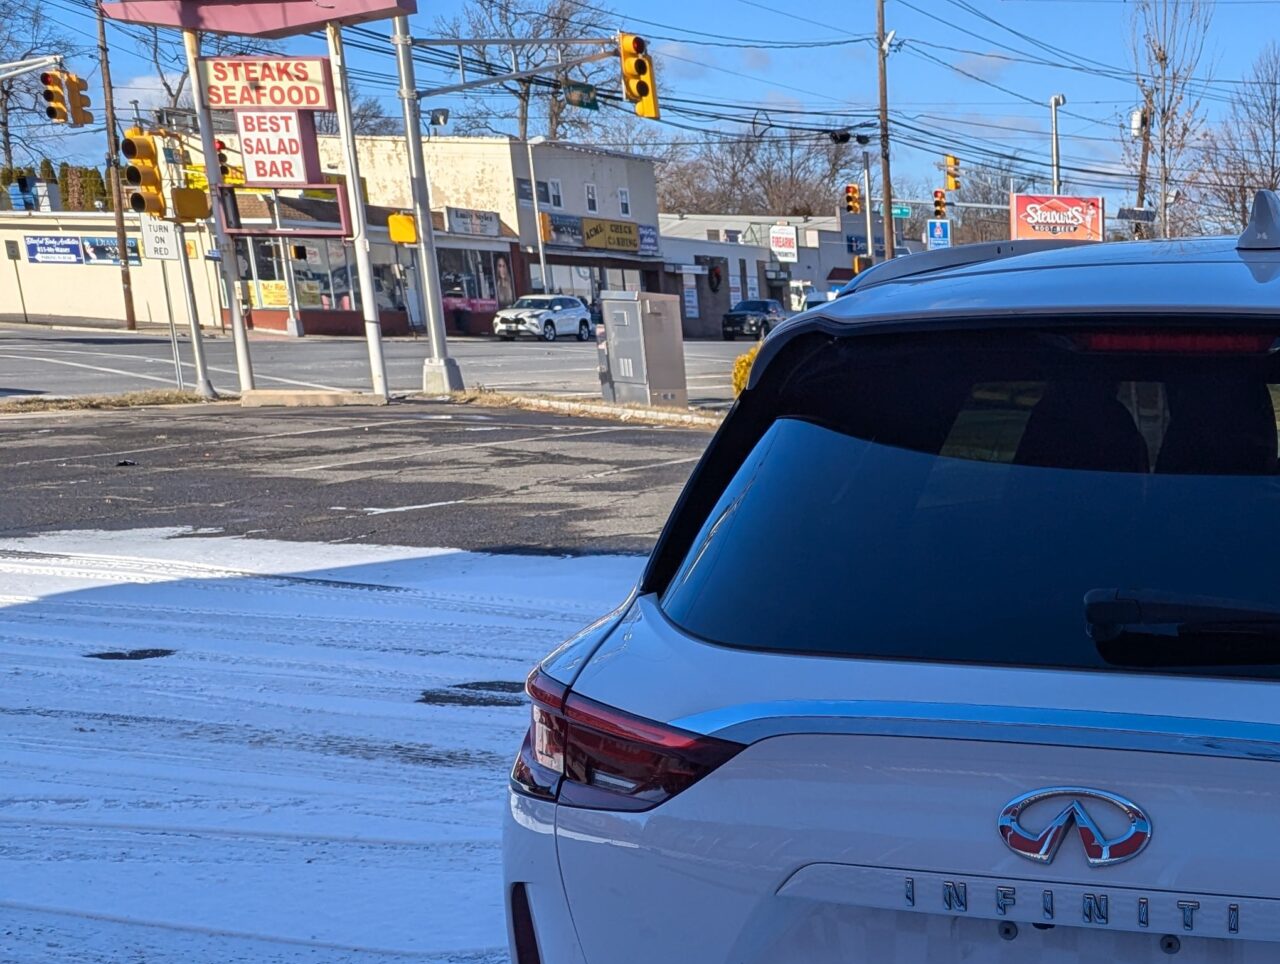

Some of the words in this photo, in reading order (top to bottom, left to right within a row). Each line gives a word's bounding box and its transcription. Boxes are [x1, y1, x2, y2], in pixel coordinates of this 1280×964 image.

[213, 62, 309, 82] STEAKS
[207, 85, 320, 105] SEAFOOD
[243, 115, 292, 133] BEST
[243, 138, 300, 155] SALAD
[255, 160, 295, 178] BAR
[148, 224, 169, 232] TURN
[154, 236, 165, 244] ON
[153, 247, 169, 255] RED
[905, 877, 1239, 933] INFINITI
